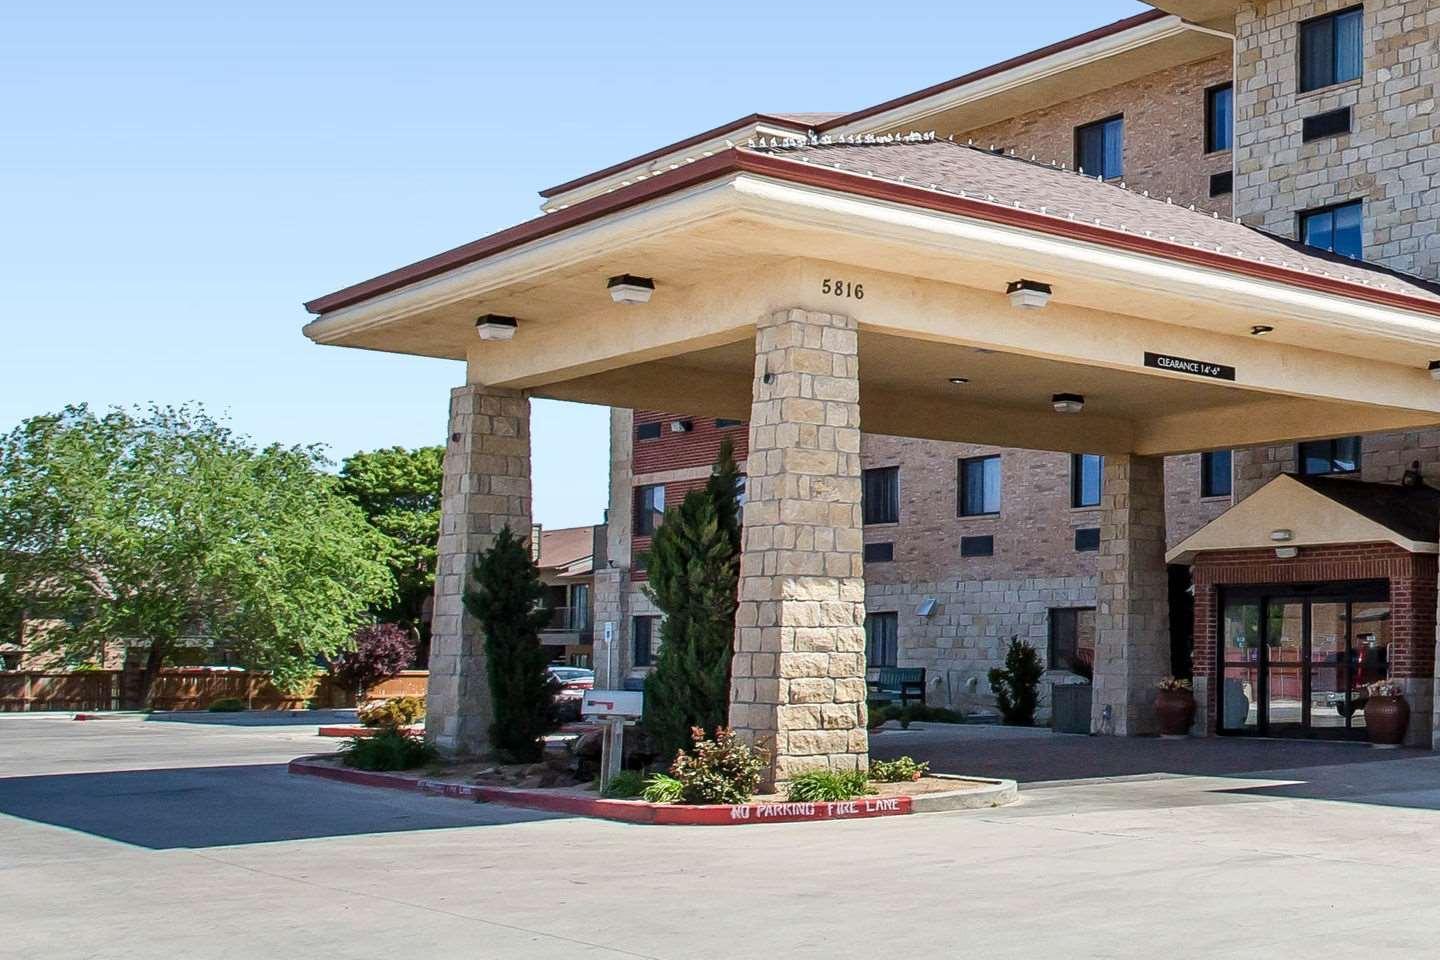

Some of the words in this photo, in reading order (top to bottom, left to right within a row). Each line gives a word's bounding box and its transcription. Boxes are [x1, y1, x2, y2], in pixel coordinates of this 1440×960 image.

[822, 279, 864, 300] 5816
[1157, 357, 1199, 372] CLEARANCE
[731, 804, 750, 819] NO
[756, 802, 815, 818] PARKING
[828, 801, 859, 816] FIRE
[866, 799, 901, 812] LANE
